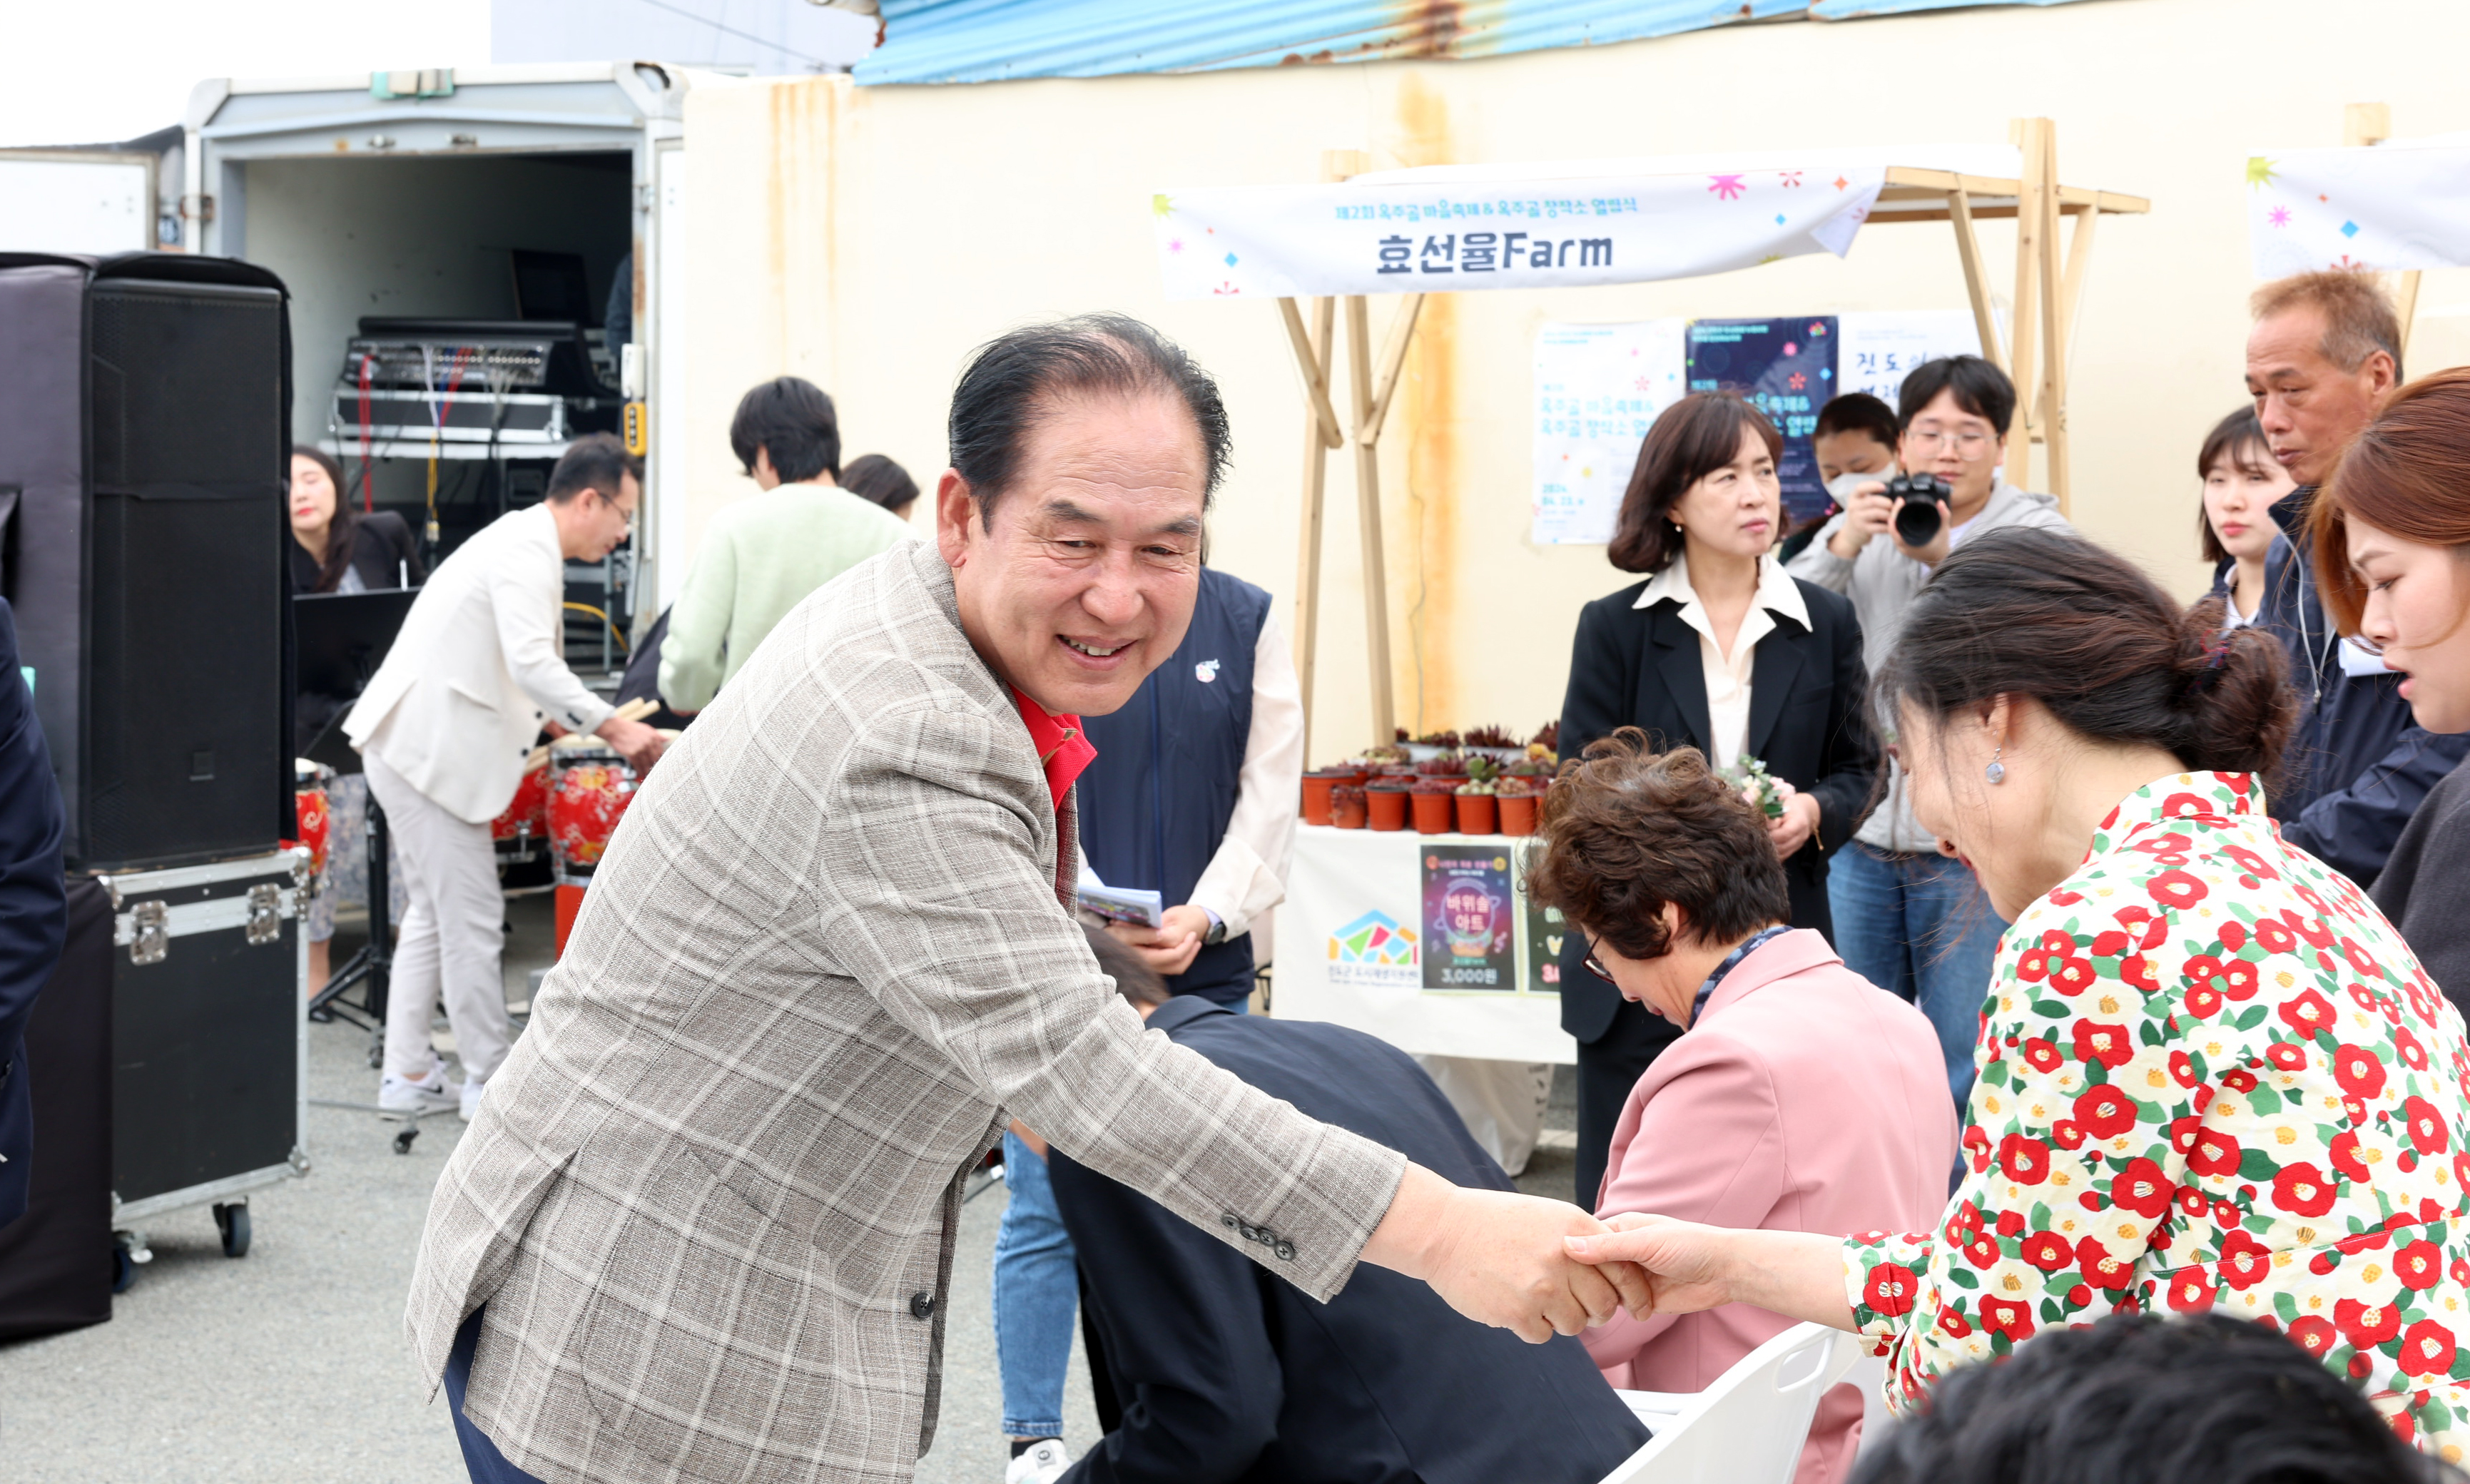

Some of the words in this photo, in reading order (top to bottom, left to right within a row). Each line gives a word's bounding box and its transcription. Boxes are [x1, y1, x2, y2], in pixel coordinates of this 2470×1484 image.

[1335, 204, 1374, 220] 제2회
[1379, 203, 1420, 222] 옥주골
[1498, 200, 1541, 218] 옥주골
[1545, 199, 1588, 218] 창작소
[1377, 233, 1612, 274] 효선율Farm
[1446, 894, 1490, 913] 바위솔
[1455, 913, 1486, 930] 아트
[1440, 967, 1498, 985] 3,000원
